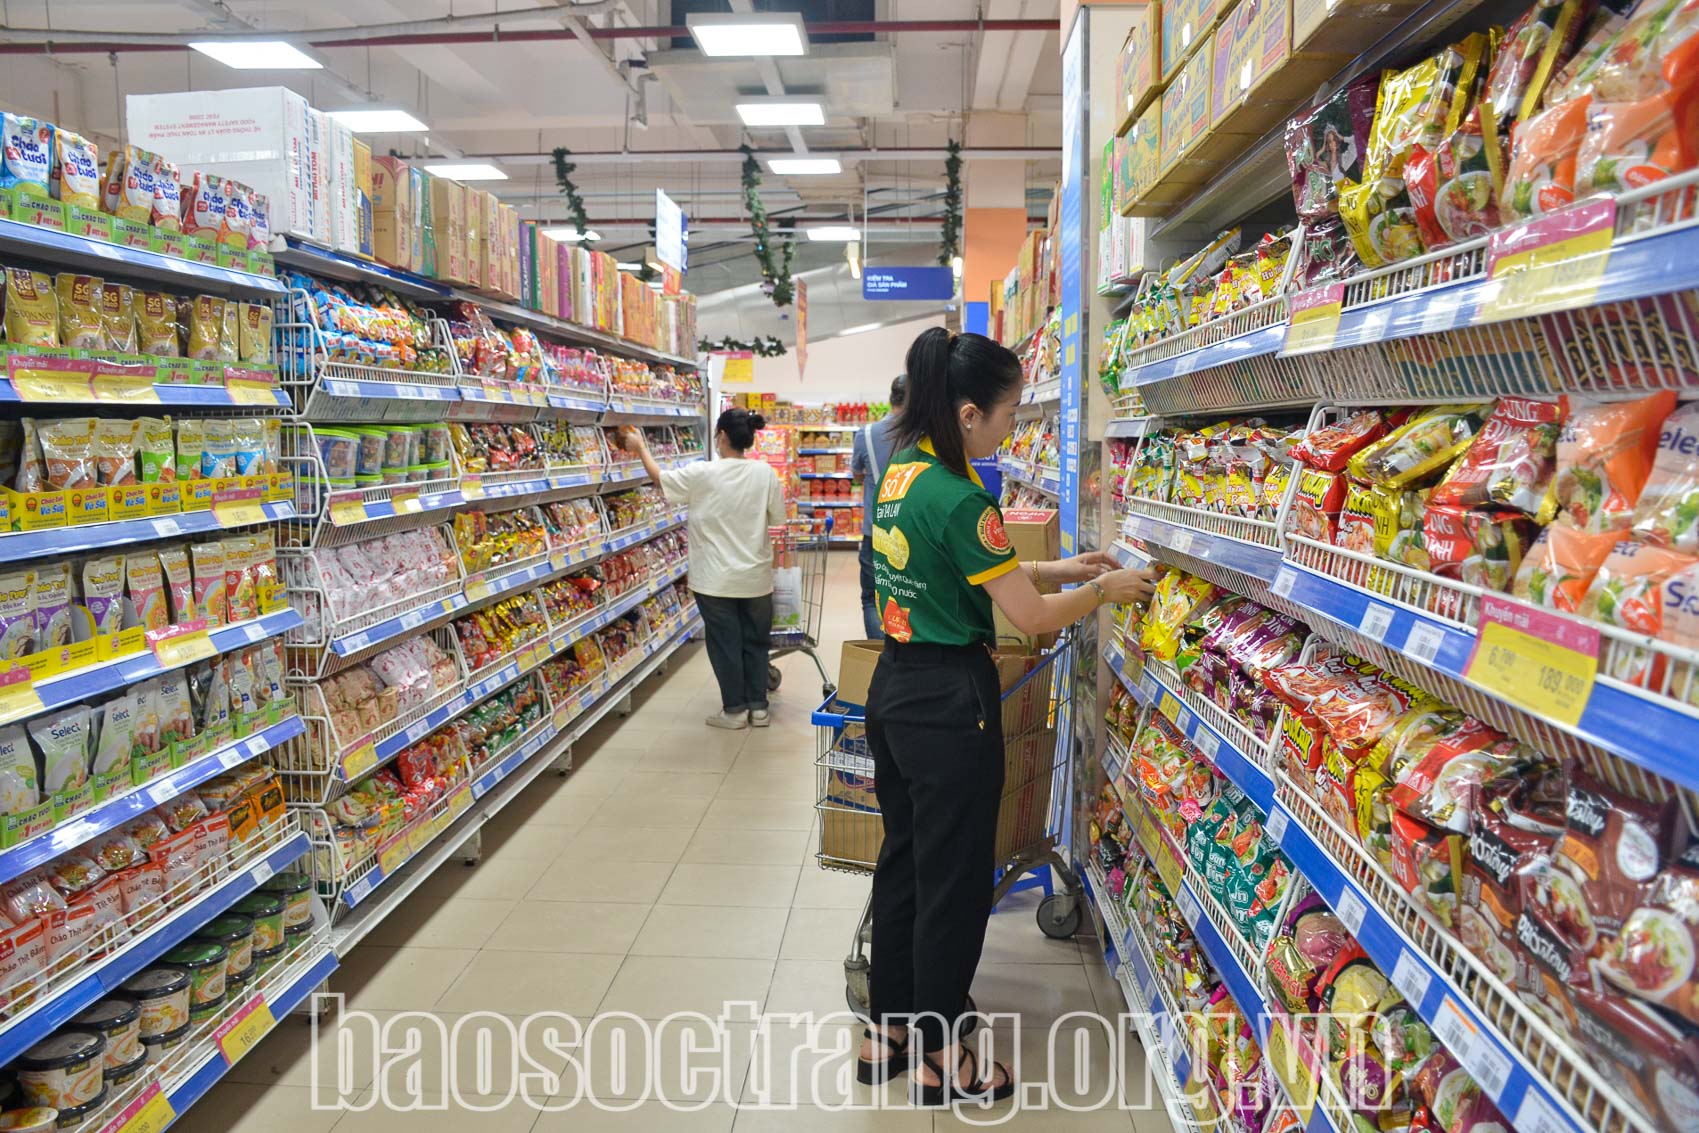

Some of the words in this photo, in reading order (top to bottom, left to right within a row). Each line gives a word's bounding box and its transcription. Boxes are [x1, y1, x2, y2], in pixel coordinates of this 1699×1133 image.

[75, 283, 90, 295] SG
[103, 291, 118, 302] SG
[147, 297, 161, 308] SG
[1494, 399, 1542, 422] CUNG
[897, 465, 917, 496] 1
[1484, 601, 1513, 623] Khuyến
[1513, 613, 1530, 629] mãi
[51, 722, 82, 740] Select
